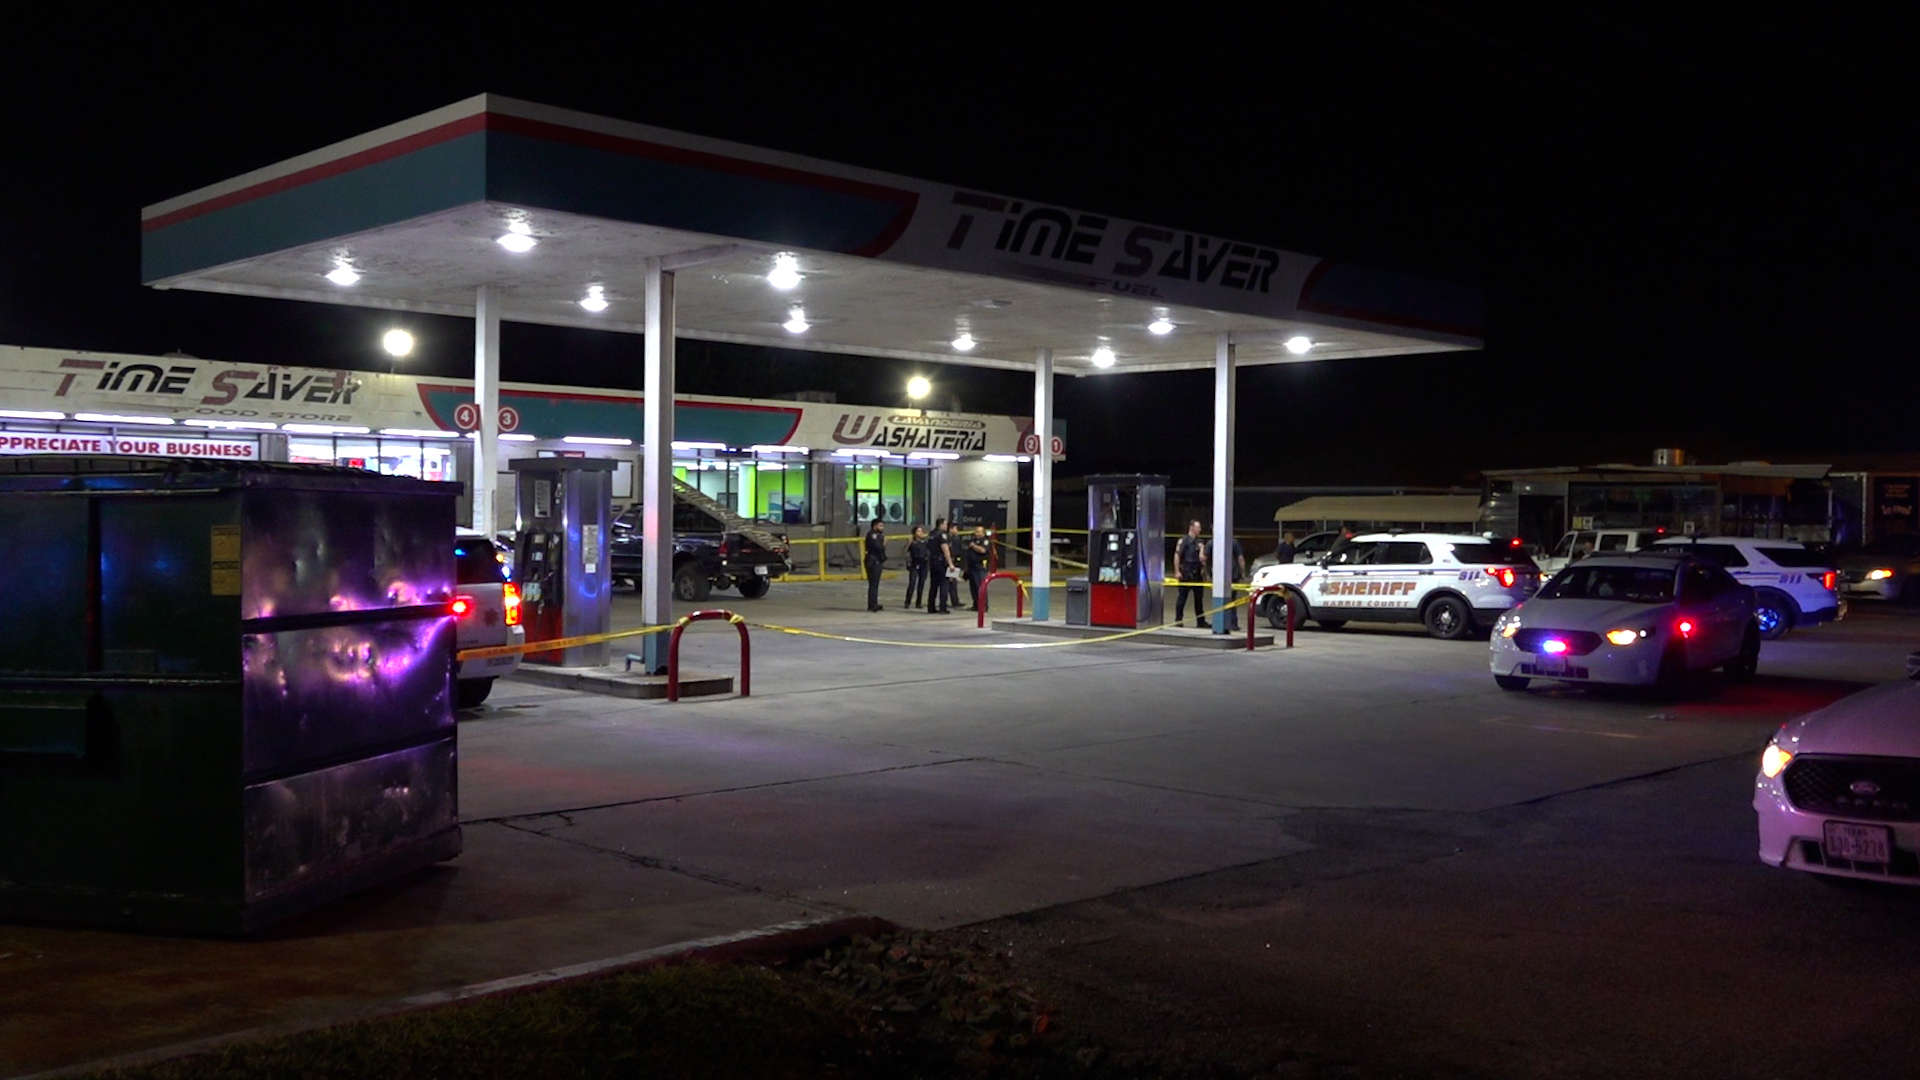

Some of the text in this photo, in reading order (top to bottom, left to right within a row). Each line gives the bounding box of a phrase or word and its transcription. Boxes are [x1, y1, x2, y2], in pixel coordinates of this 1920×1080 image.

[1112, 225, 1279, 294] SAVER
[172, 406, 352, 423] FOOD STORE
[892, 415, 983, 429] LAVANDERIA
[107, 440, 160, 454] YOUR
[166, 442, 252, 457] BUSINESS
[1329, 581, 1416, 596] SHERIFF
